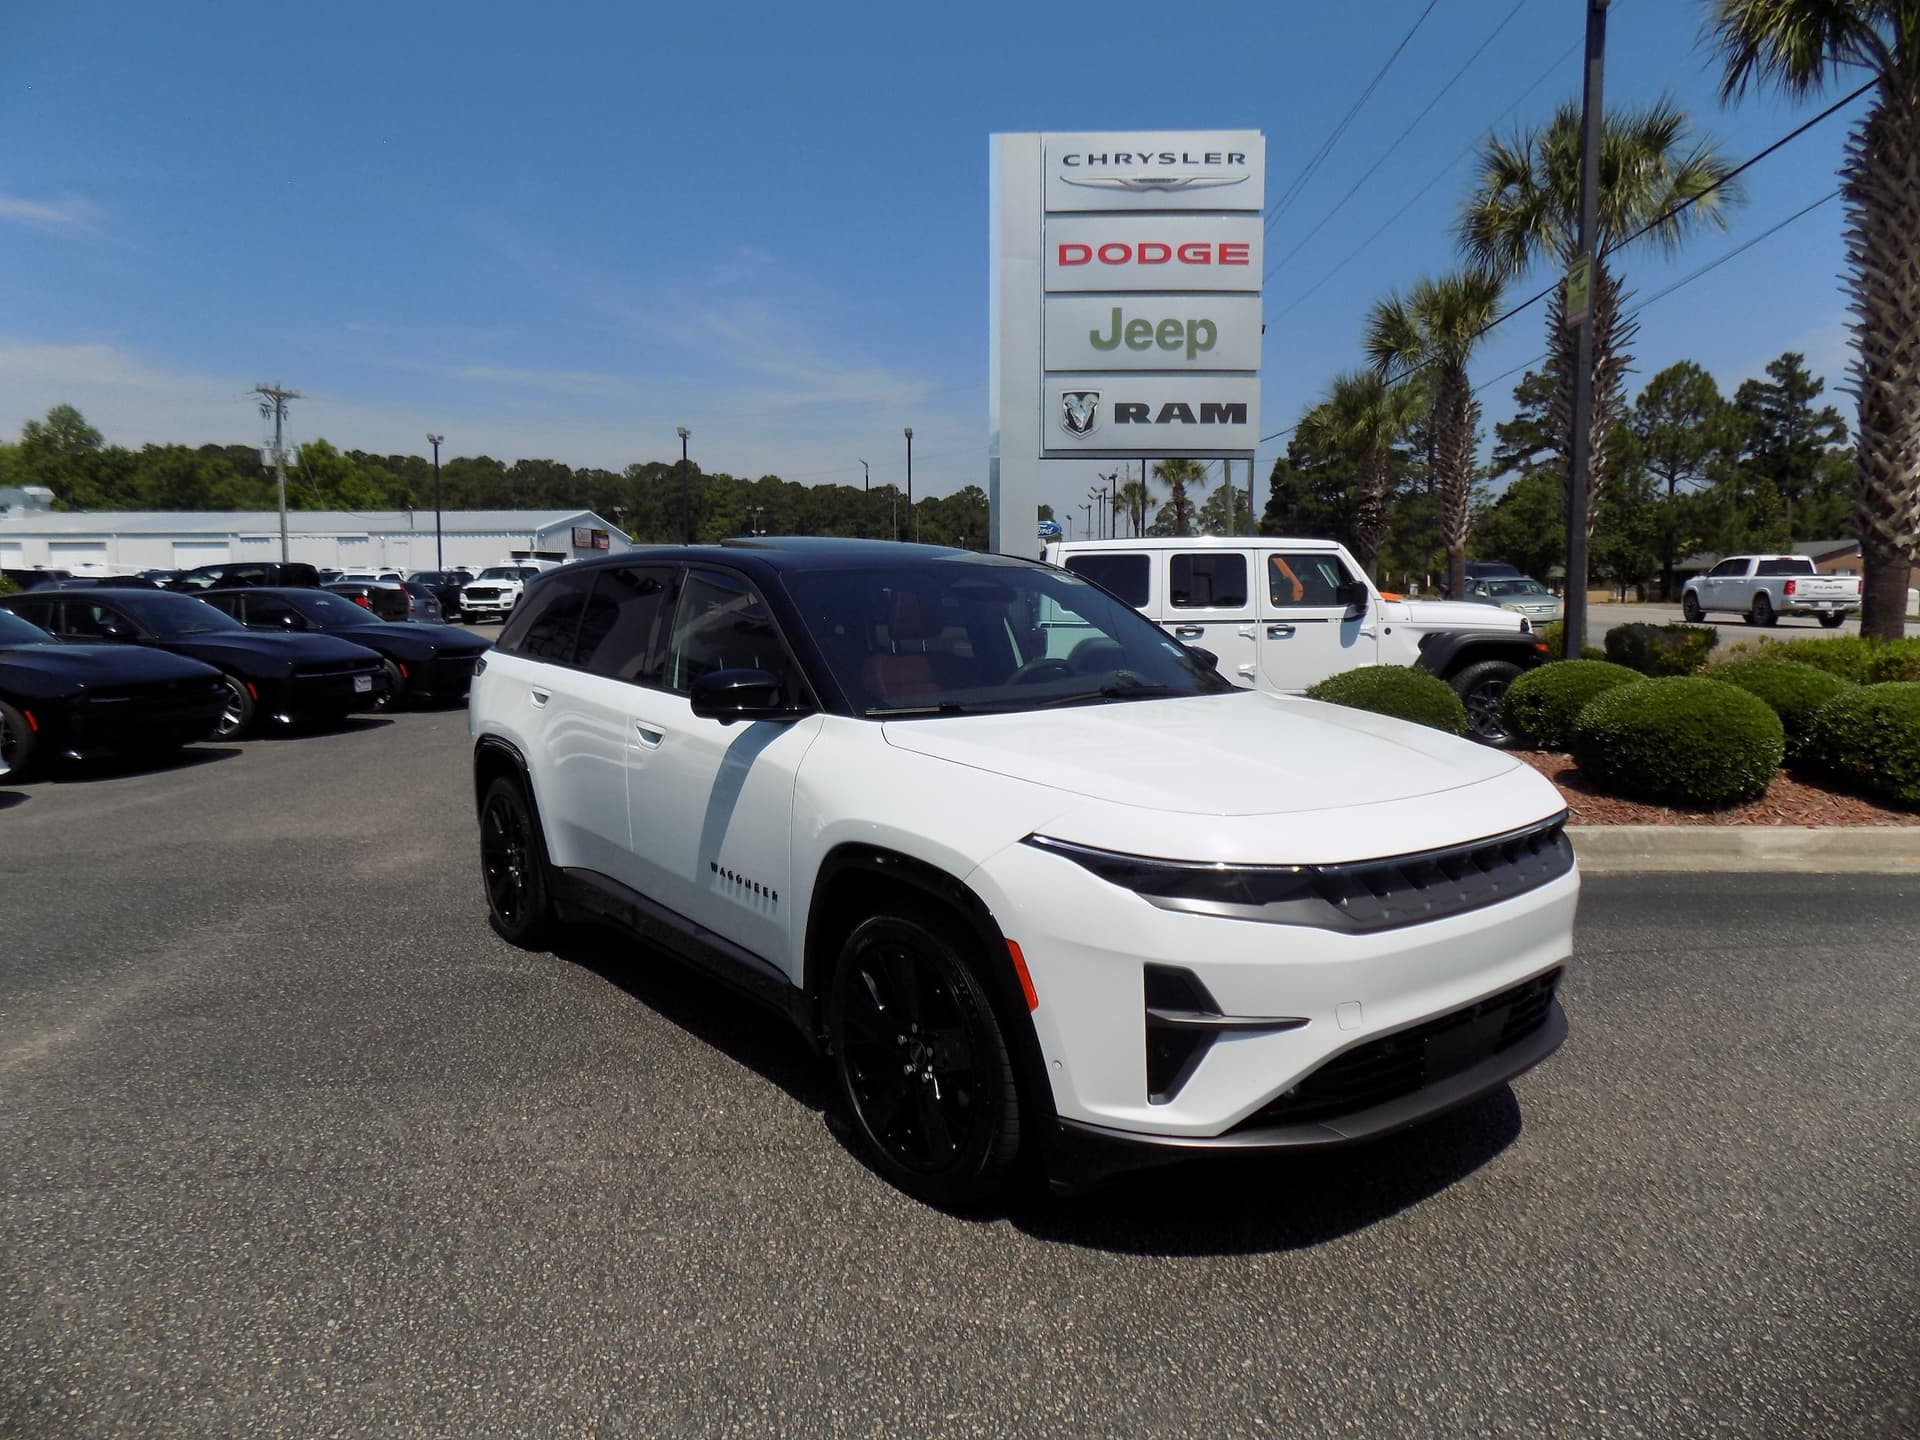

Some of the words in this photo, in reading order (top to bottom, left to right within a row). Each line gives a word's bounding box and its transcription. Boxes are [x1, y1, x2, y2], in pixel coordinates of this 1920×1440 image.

[1062, 152, 1246, 166] CHRYSLER
[1058, 243, 1250, 266] DODGE
[1089, 307, 1218, 360] Jeep
[1114, 402, 1247, 424] RAM
